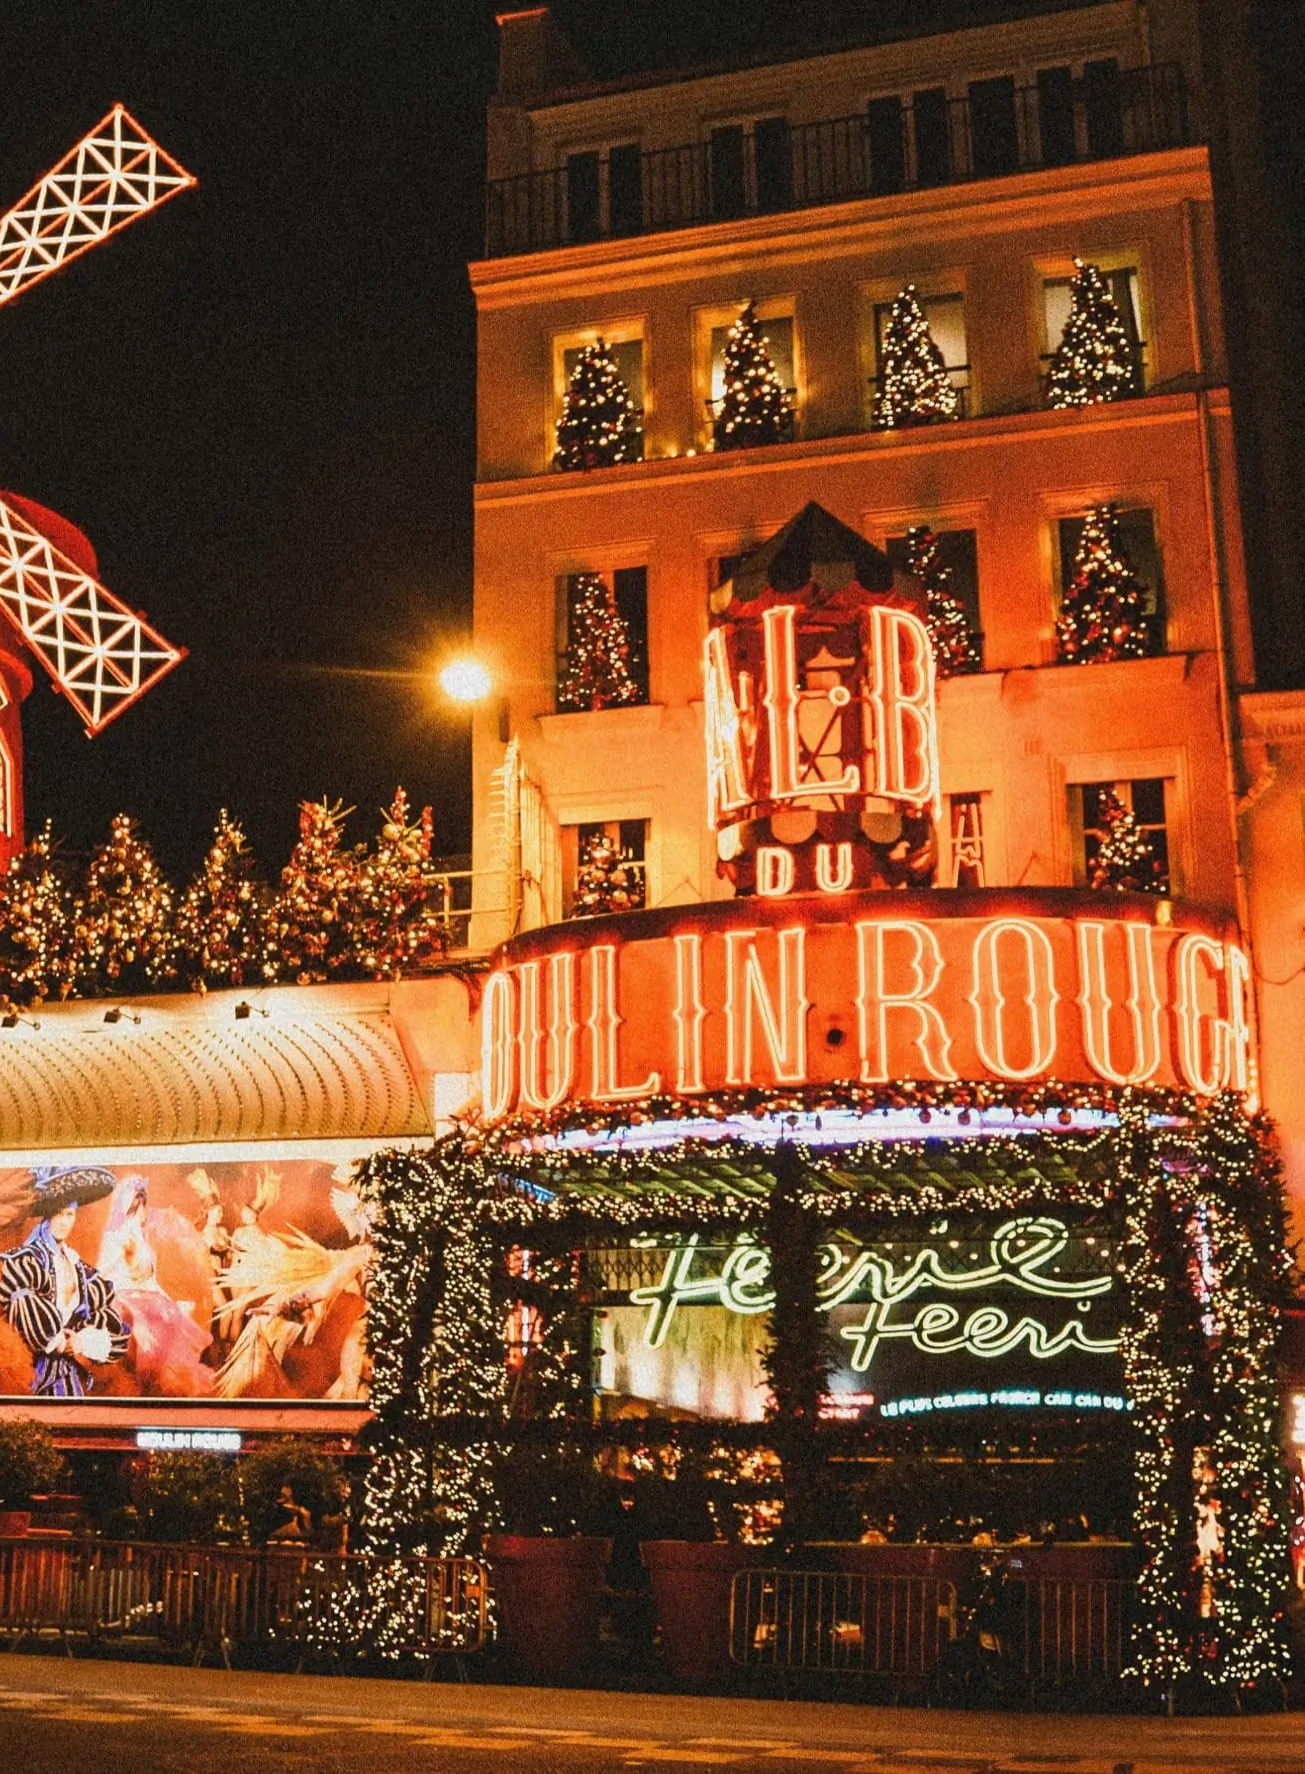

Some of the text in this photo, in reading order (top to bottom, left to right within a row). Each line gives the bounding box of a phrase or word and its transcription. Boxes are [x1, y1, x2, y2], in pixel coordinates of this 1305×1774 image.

[757, 843, 852, 896] DU
[880, 1402, 899, 1417] LE
[899, 1397, 932, 1414] PLUS
[1045, 1393, 1072, 1406] CAN
[1075, 1394, 1102, 1408] CAN
[1103, 1397, 1123, 1411] DU
